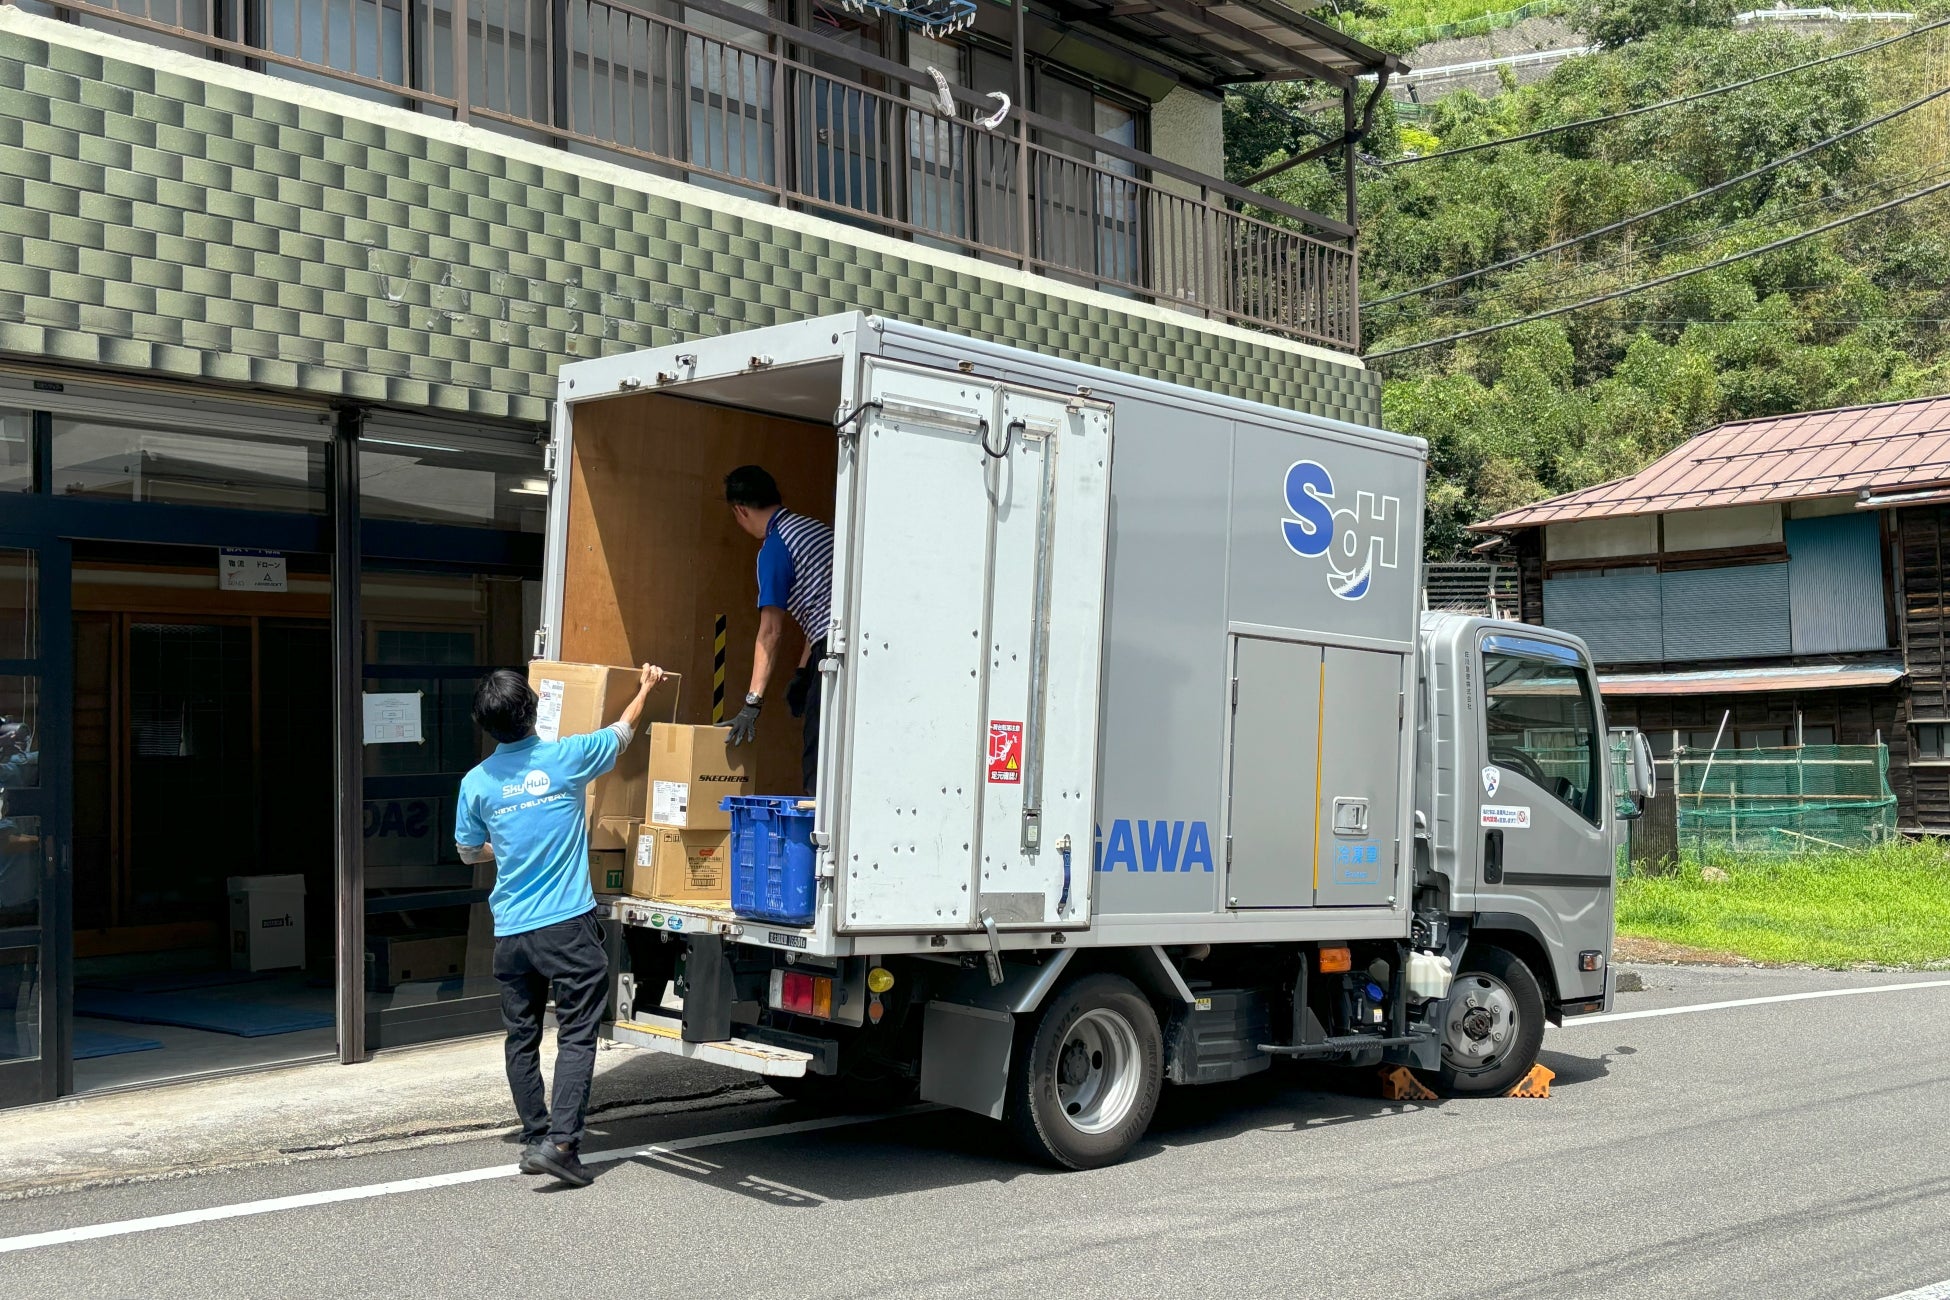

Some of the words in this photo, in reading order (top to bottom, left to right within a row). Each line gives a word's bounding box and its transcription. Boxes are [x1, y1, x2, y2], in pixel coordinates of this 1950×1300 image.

[257, 561, 280, 569] ドローン
[698, 774, 750, 783] SKECHERS
[494, 804, 518, 816] NEXT
[520, 792, 567, 810] DELIVERY
[1095, 819, 1214, 872] AWA
[677, 974, 684, 987] あ
